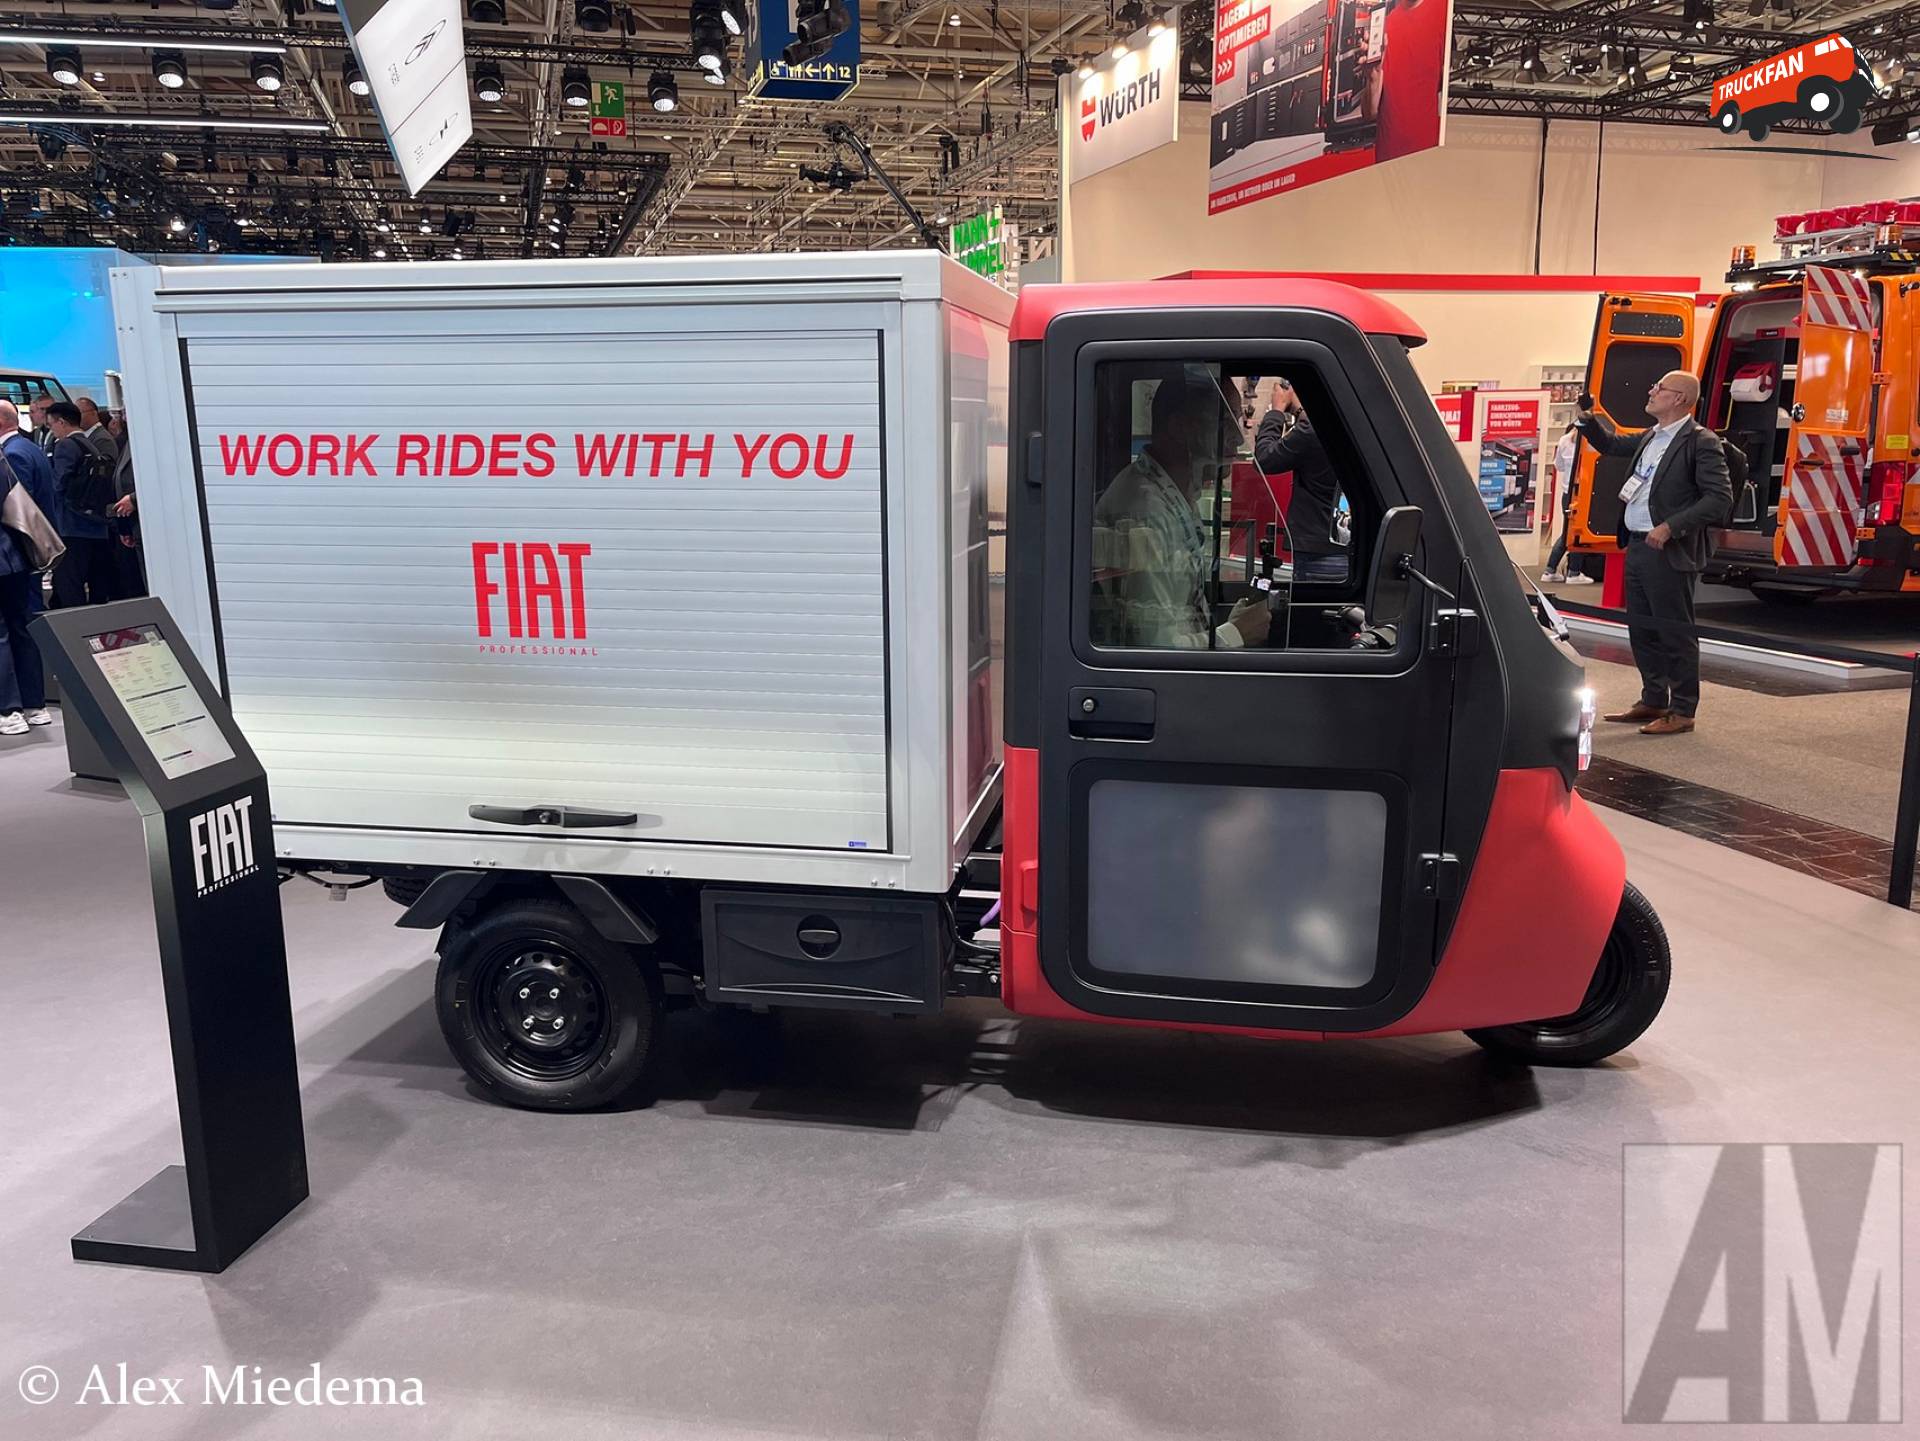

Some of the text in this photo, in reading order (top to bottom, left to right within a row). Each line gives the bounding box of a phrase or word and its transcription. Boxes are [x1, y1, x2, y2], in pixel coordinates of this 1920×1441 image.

[1219, 13, 1268, 55] OPTIMIEREN
[838, 66, 851, 79] 12
[218, 433, 854, 479] WORK RIDES WITH YOU
[472, 542, 592, 640] FIAT
[479, 645, 599, 657] PROFESSIONAL
[189, 795, 254, 890] FIAT
[197, 864, 260, 898] PROFESSIONAL
